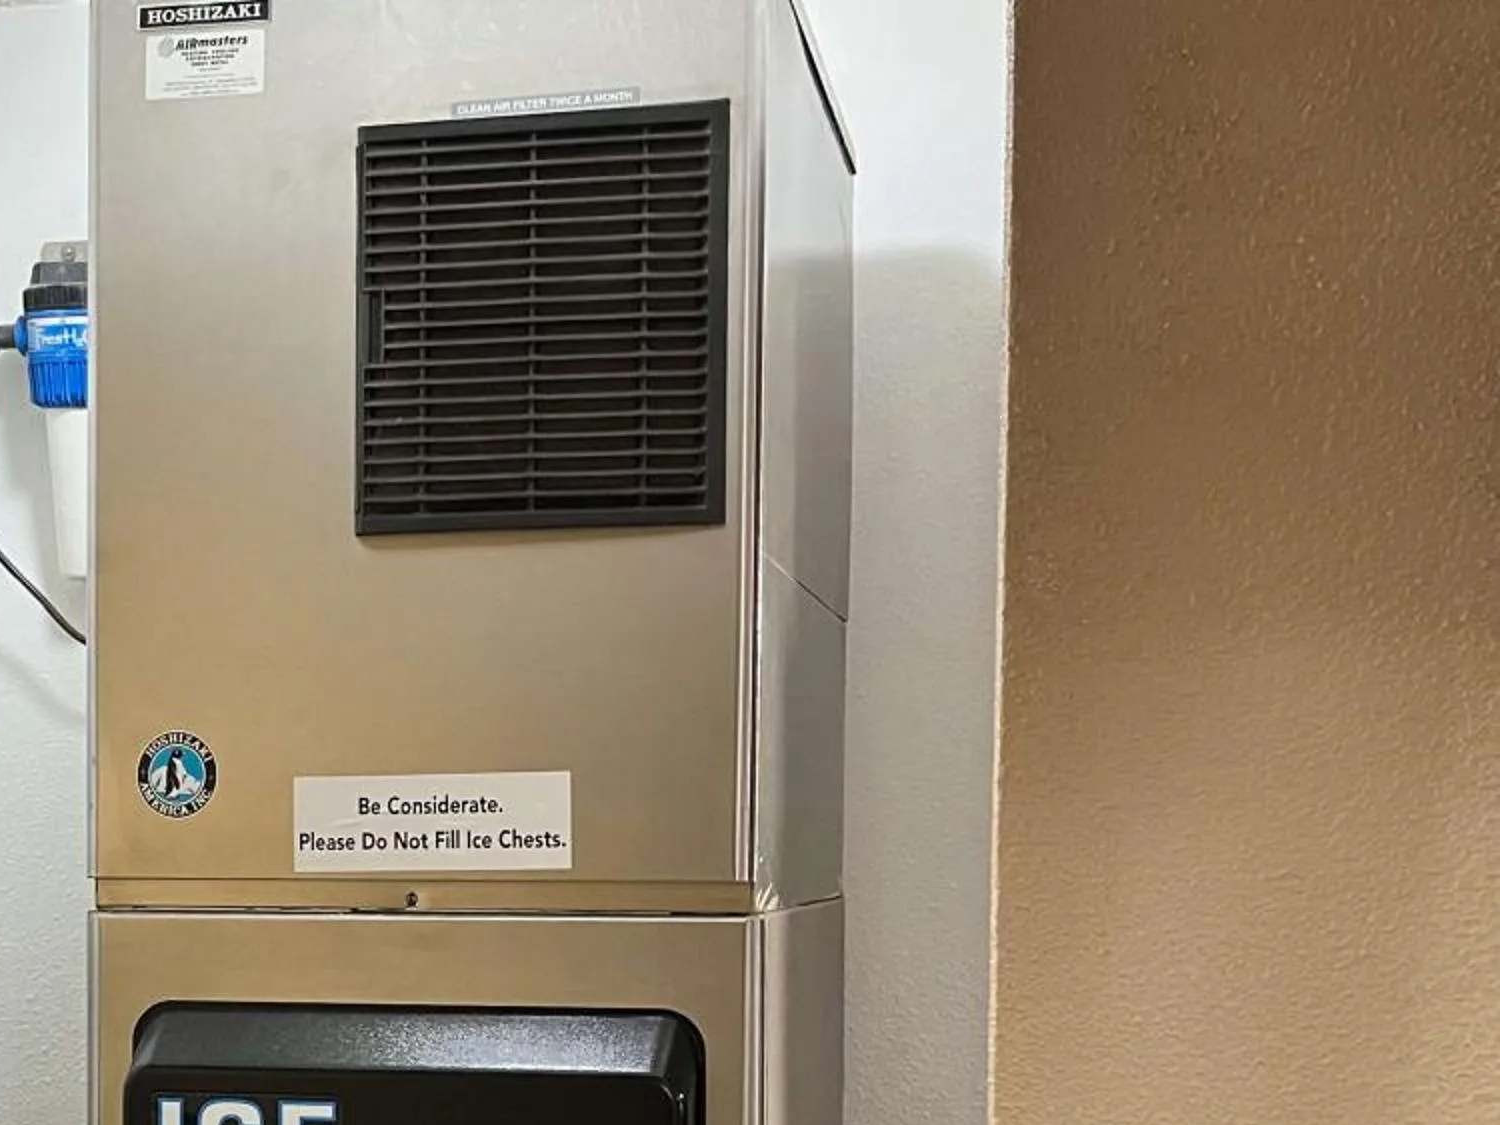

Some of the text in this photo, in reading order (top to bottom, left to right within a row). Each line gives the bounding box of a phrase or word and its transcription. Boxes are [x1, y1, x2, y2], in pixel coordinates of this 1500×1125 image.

[148, 4, 261, 24] HOSHIZAKI
[457, 102, 491, 115] CLEAN
[494, 100, 510, 113] AIR
[513, 98, 547, 111] FILTER
[584, 94, 593, 105] A
[594, 90, 633, 104] MONTH
[145, 732, 213, 762] HOSHIZAKI
[358, 794, 503, 815] Be Considerate.
[299, 829, 567, 851] Please Do Not Fill Ice Chests.
